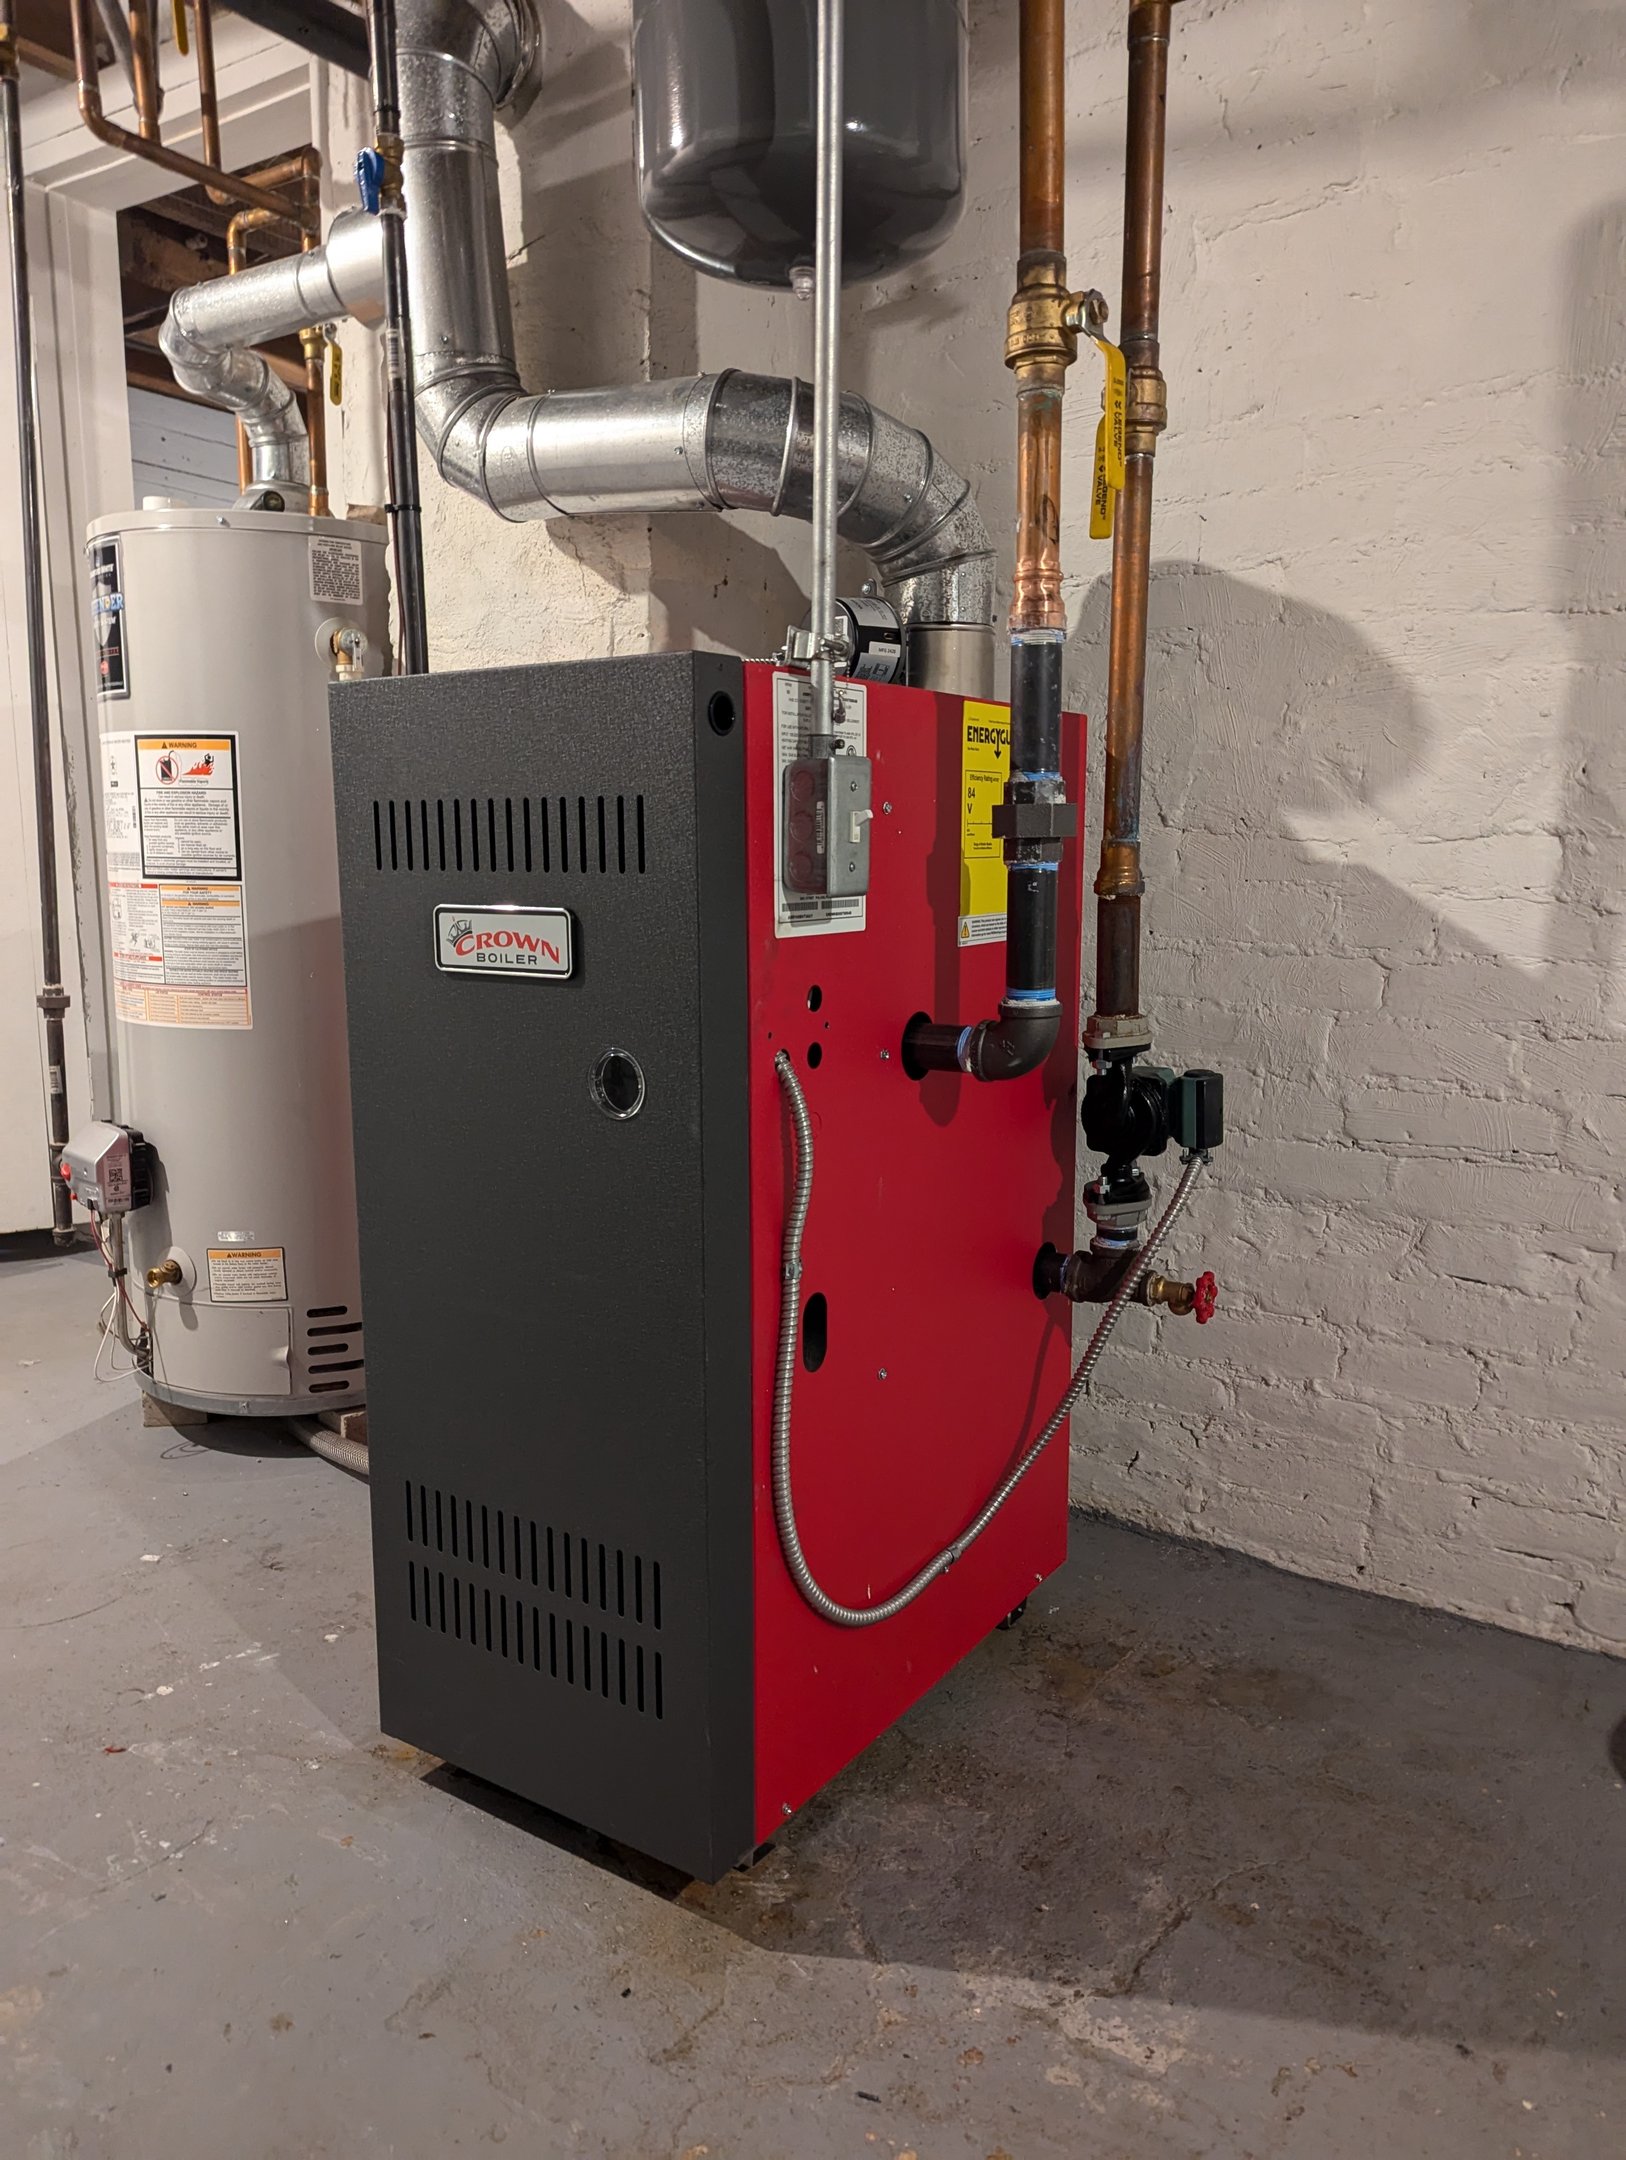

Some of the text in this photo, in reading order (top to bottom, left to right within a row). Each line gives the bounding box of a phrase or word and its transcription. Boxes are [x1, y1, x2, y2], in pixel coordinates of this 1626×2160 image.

[967, 787, 976, 798] 84
[967, 803, 973, 814] V
[455, 931, 560, 964] CROWN
[476, 953, 538, 965] BOILER
